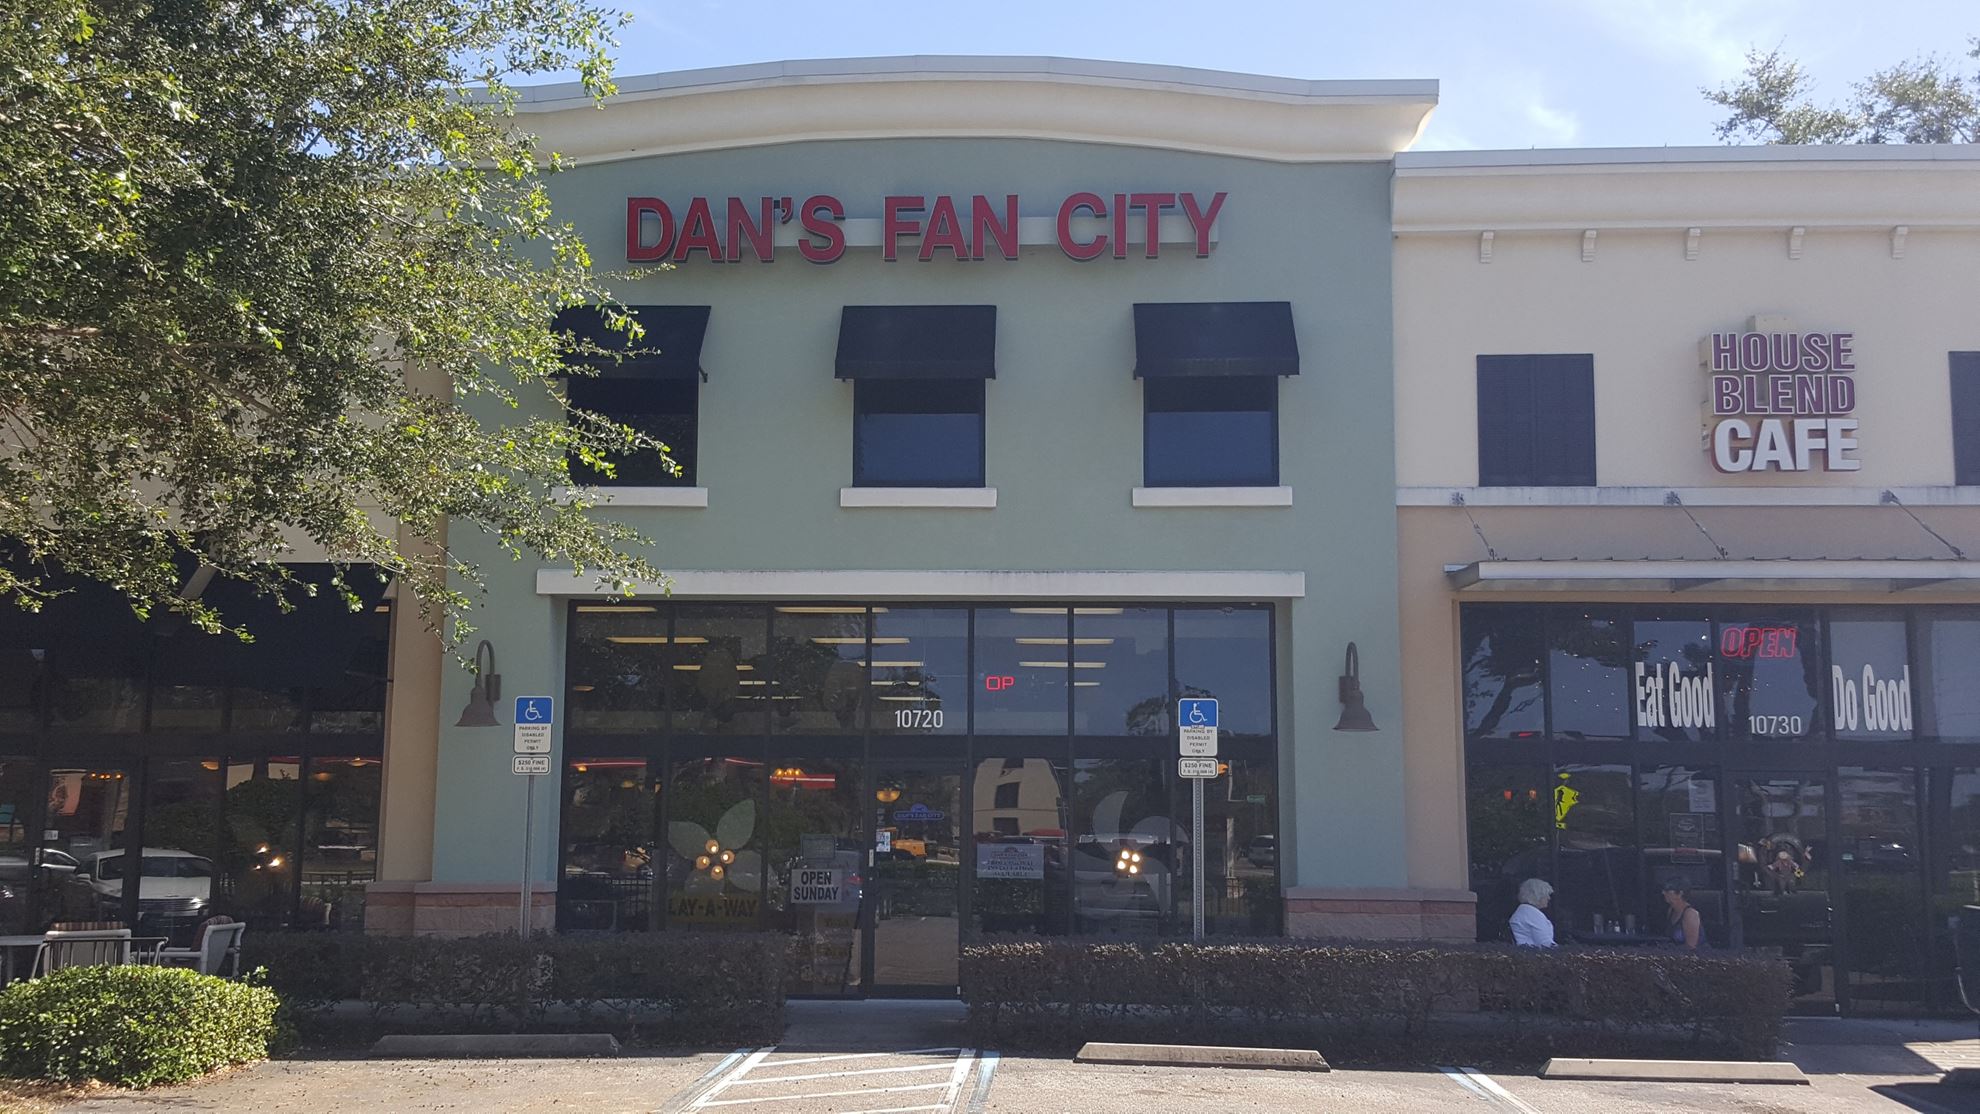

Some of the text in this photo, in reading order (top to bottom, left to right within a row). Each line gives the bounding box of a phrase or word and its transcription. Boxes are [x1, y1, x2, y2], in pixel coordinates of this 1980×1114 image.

[625, 192, 1229, 263] DAN'S FAN CITY
[1711, 332, 1856, 373] HOUSE
[1712, 375, 1856, 415] BLEND
[1713, 418, 1861, 472] CAFE
[1721, 627, 1797, 658] OPEN
[1635, 661, 1715, 727] Eat Good
[1832, 663, 1912, 731] Do Good
[894, 710, 944, 728] 10720
[1748, 715, 1801, 735] 10730
[794, 886, 839, 900] SUNDAY
[801, 871, 832, 885] OPEN
